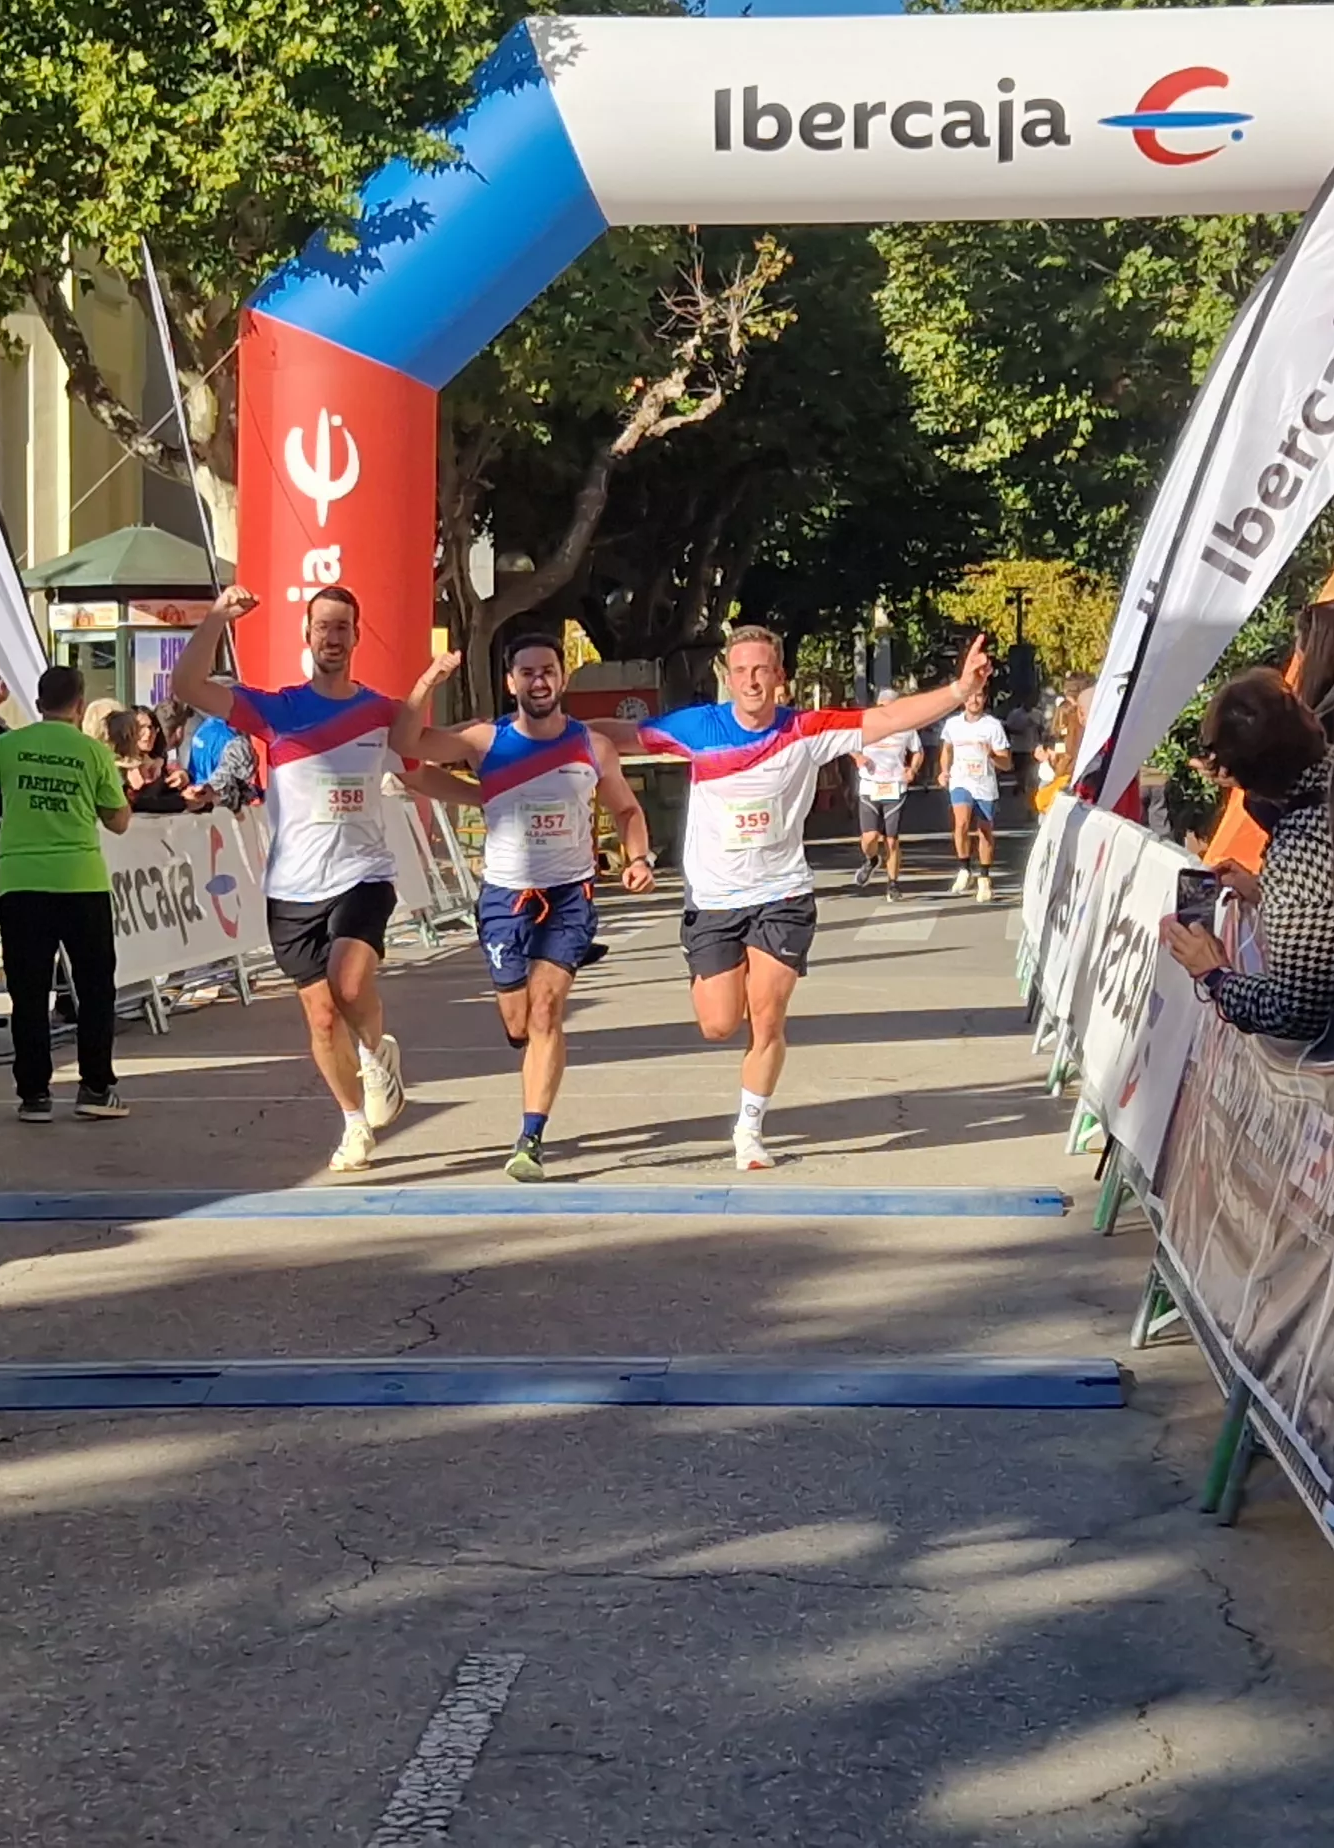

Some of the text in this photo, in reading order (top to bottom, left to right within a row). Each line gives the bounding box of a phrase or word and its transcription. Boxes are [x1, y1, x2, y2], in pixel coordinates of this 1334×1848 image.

[714, 77, 1071, 163] Ibercaja
[327, 788, 365, 805] 358
[530, 812, 566, 830] 357
[734, 811, 771, 829] 359
